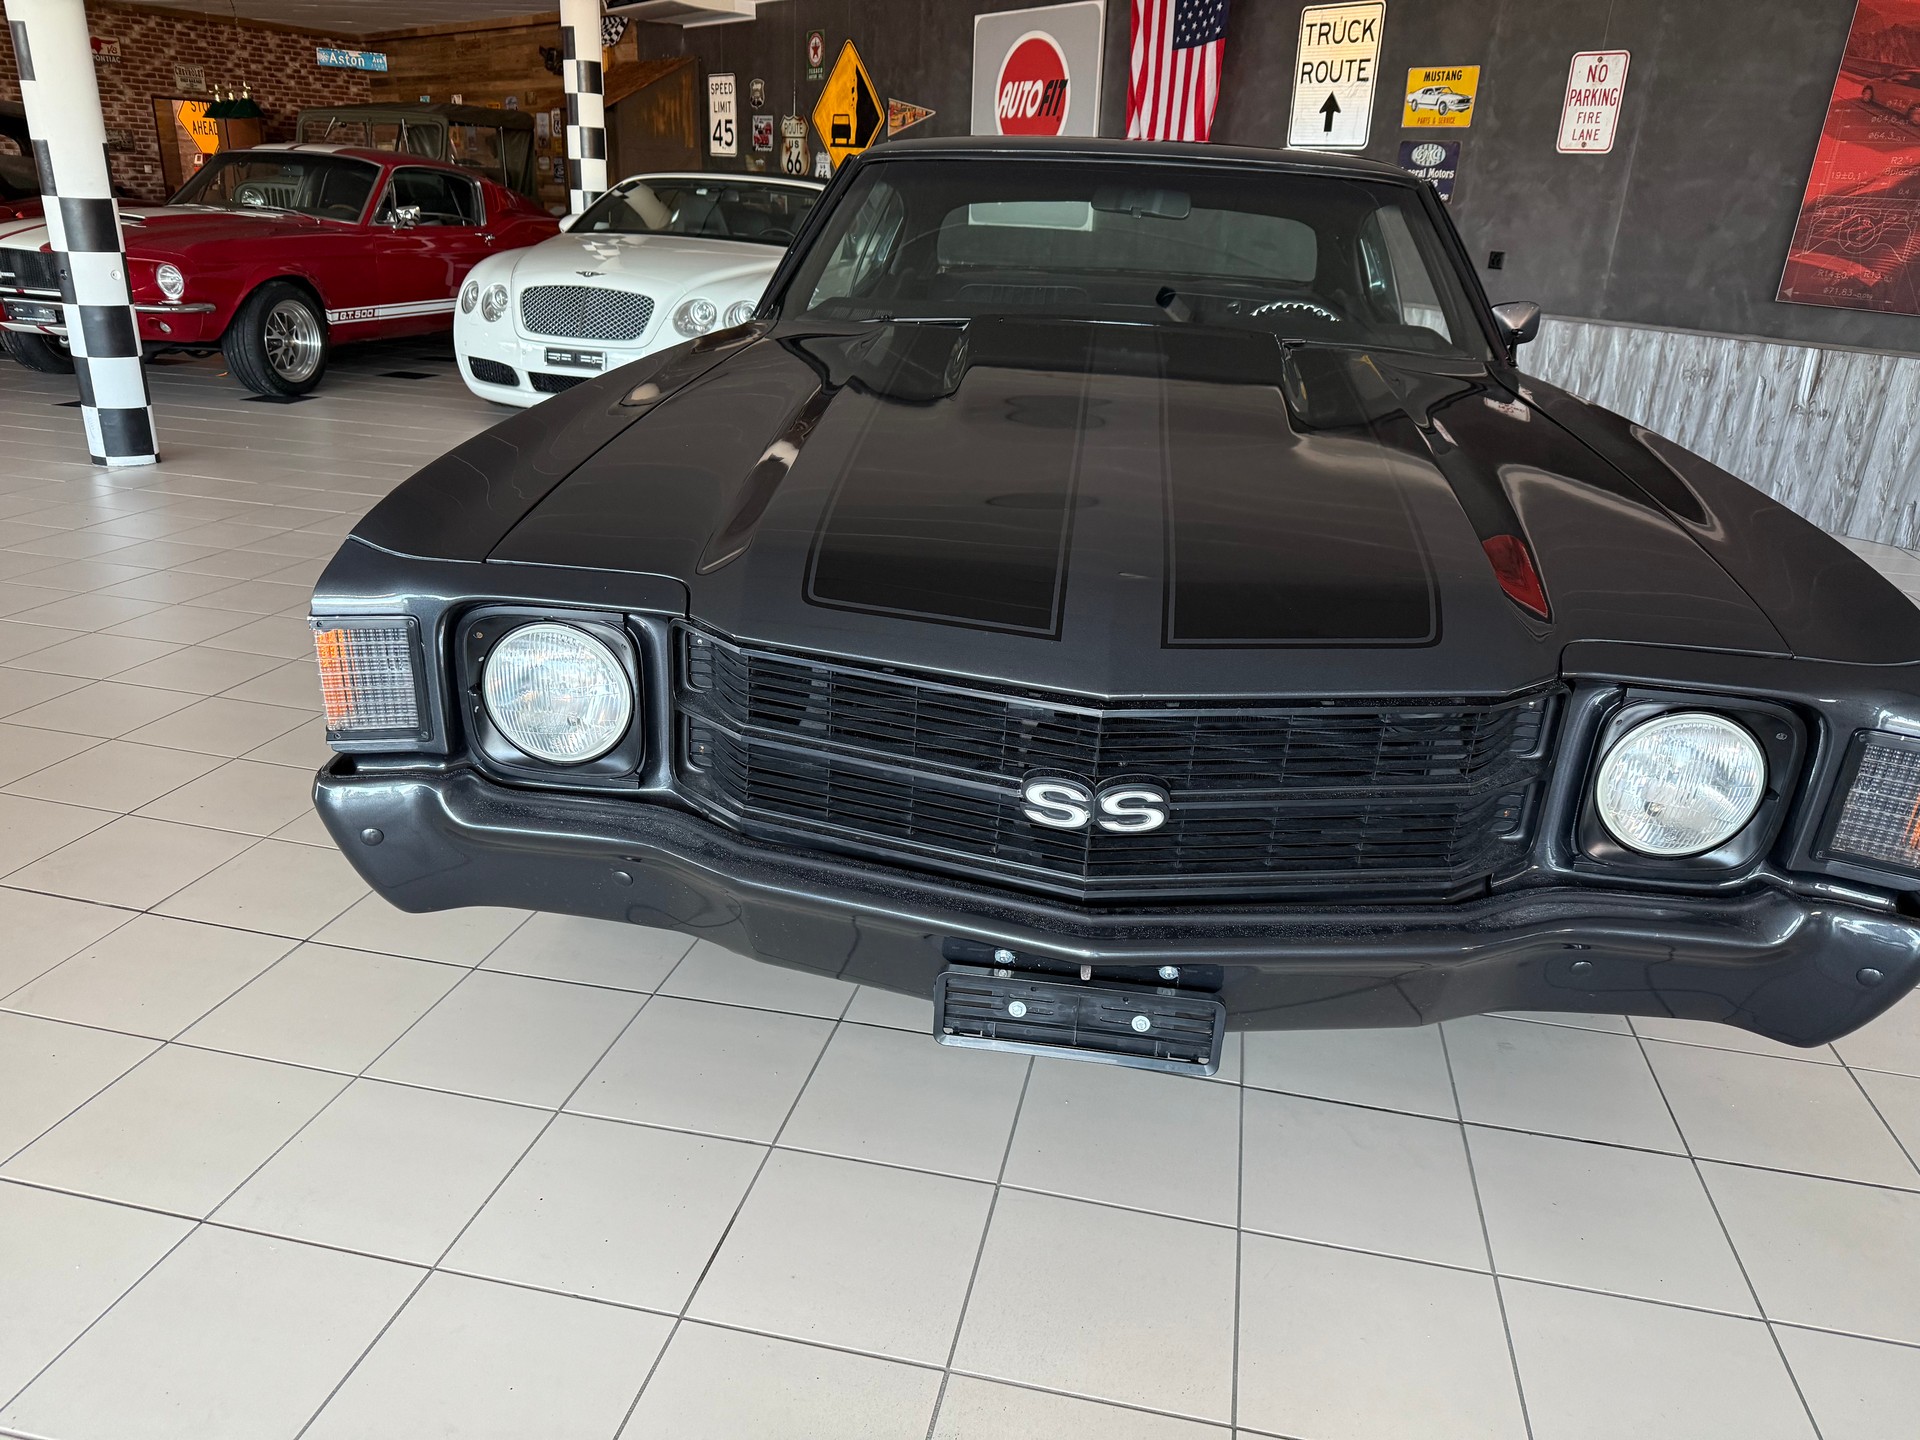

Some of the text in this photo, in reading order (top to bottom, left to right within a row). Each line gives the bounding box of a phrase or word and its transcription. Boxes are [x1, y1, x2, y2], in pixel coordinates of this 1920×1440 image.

[1306, 18, 1377, 46] TRUCK
[93, 55, 120, 63] ONTIAC
[329, 51, 365, 67] Aston
[1300, 58, 1371, 84] ROUTE
[1423, 70, 1462, 82] MUSTANG
[1587, 64, 1608, 83] NO
[711, 82, 733, 95] SPEED
[1000, 79, 1068, 118] AUTOFIT
[1568, 88, 1618, 107] PARKING
[190, 101, 212, 113] STO
[714, 101, 731, 113] LIMIT
[1577, 112, 1602, 124] FIRE
[713, 119, 734, 147] 45
[784, 123, 803, 134] ROUTE
[1572, 129, 1600, 141] LANE
[789, 140, 800, 149] US
[787, 151, 801, 173] 66
[1427, 168, 1455, 179] Motors
[1024, 783, 1165, 832] SS
